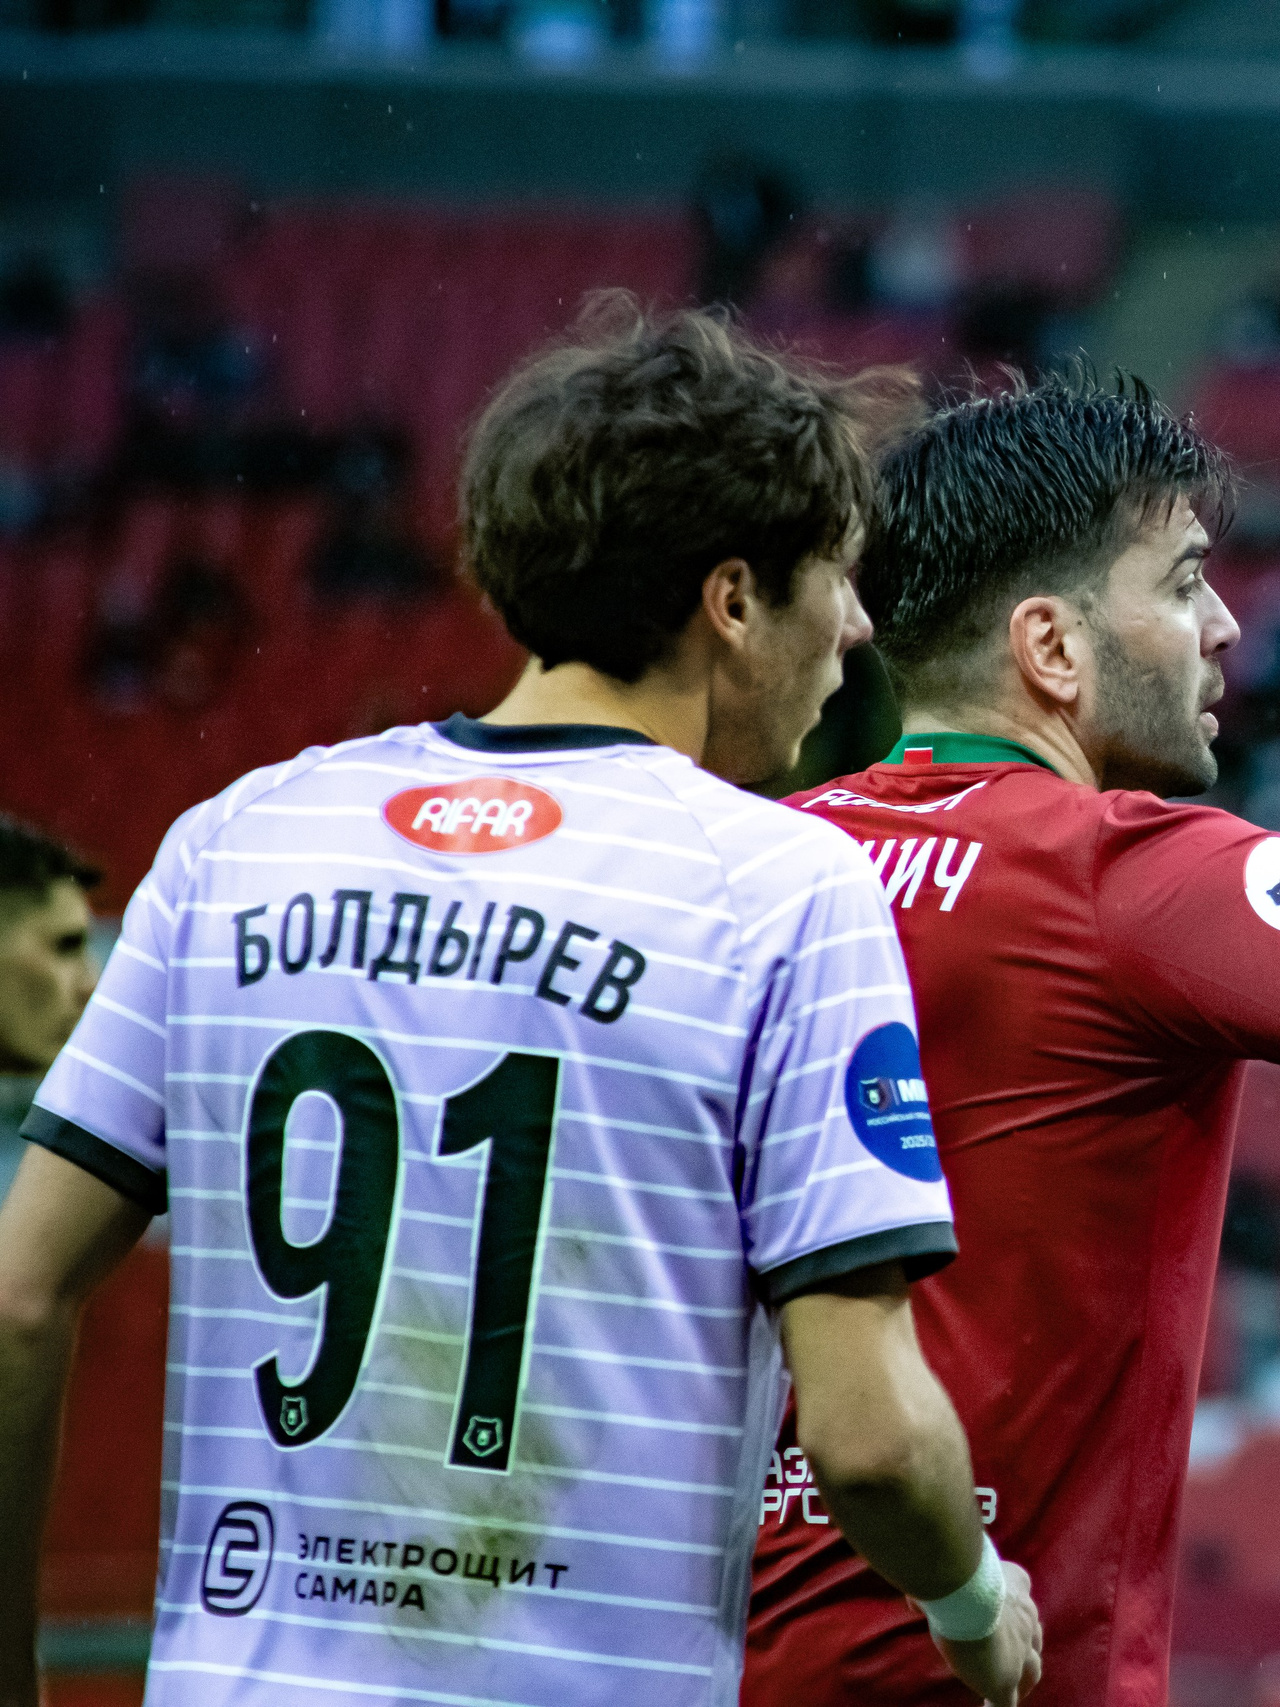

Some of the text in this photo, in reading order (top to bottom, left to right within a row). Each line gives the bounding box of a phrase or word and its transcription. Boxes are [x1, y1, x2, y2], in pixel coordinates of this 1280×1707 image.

[411, 797, 534, 838] RIFAR
[232, 888, 647, 1024] БОЛДЫРЕВ
[240, 1029, 564, 1476] 91
[297, 1533, 569, 1590] ЭЛЕКТРОЩИТ
[294, 1572, 426, 1612] САМАРА
